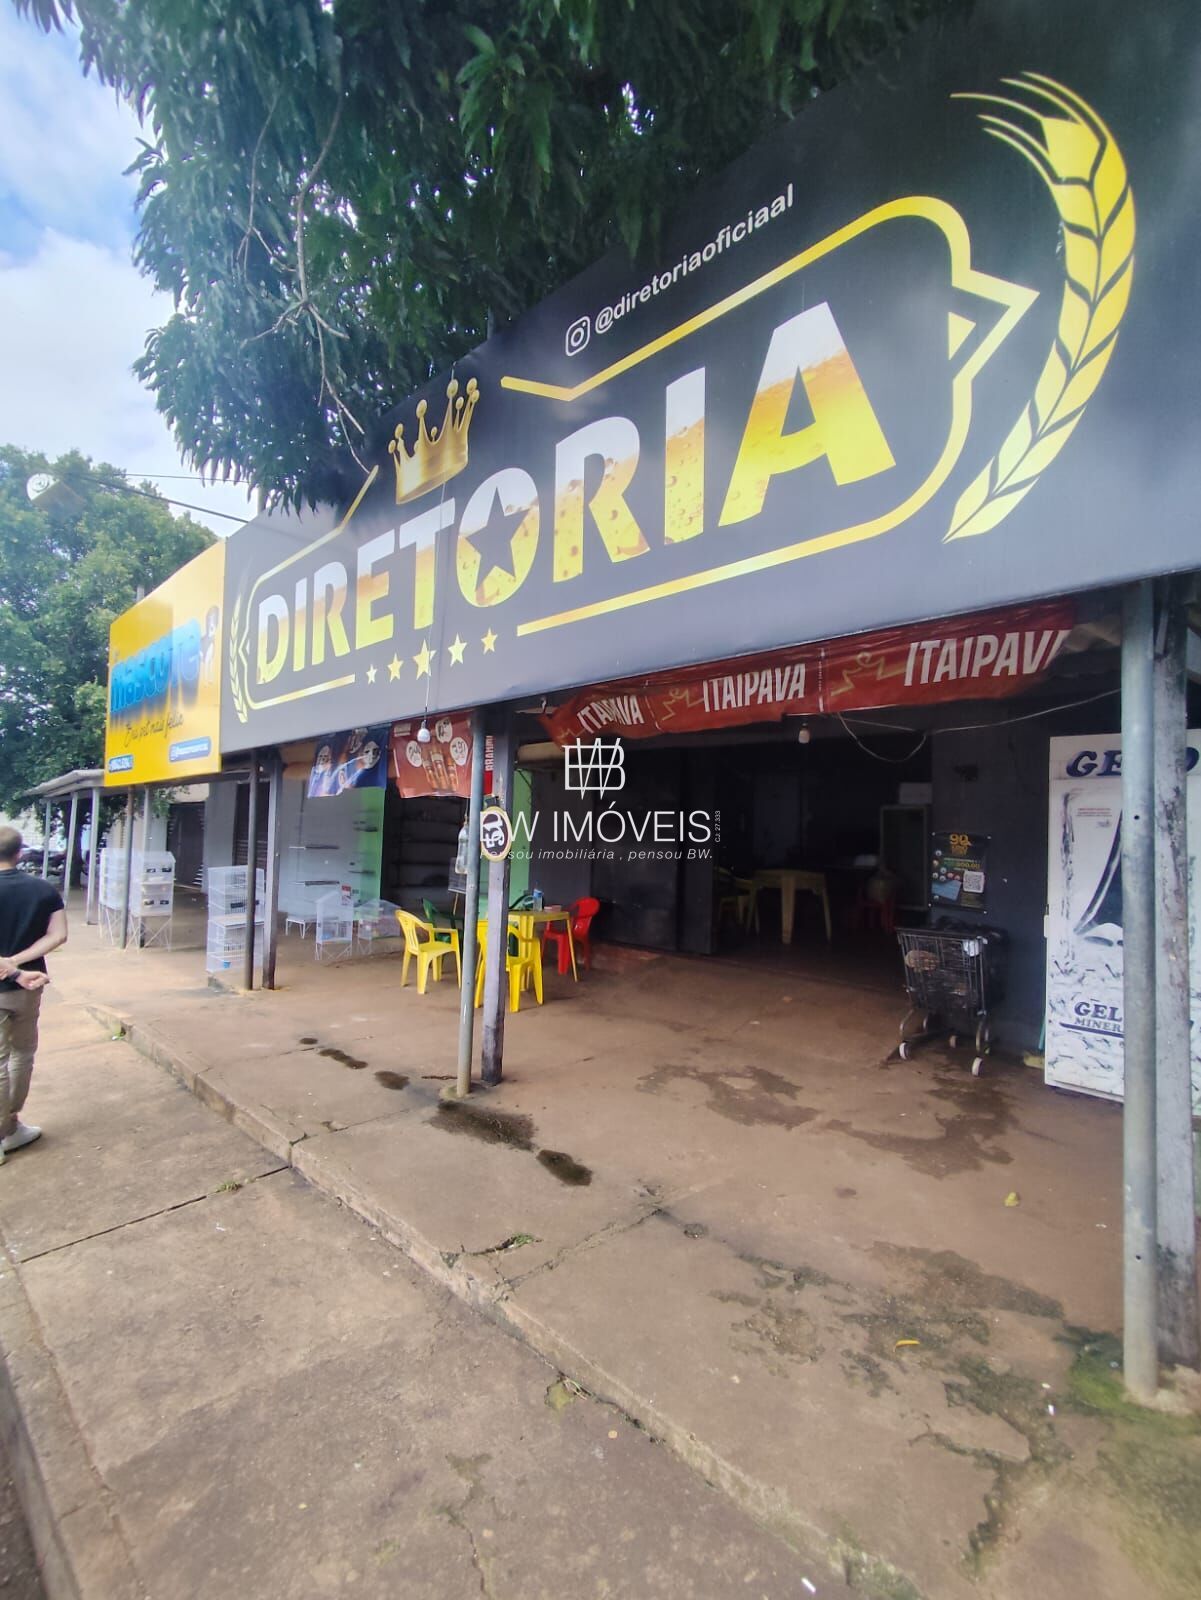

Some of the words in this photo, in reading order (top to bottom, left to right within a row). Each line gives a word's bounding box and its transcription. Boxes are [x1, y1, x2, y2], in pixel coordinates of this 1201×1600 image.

[595, 183, 794, 335] @diretoriaoficiaal
[257, 301, 896, 685] DIRETORIA
[576, 695, 645, 734] ITAVA
[702, 663, 806, 713] ITAIPAVA
